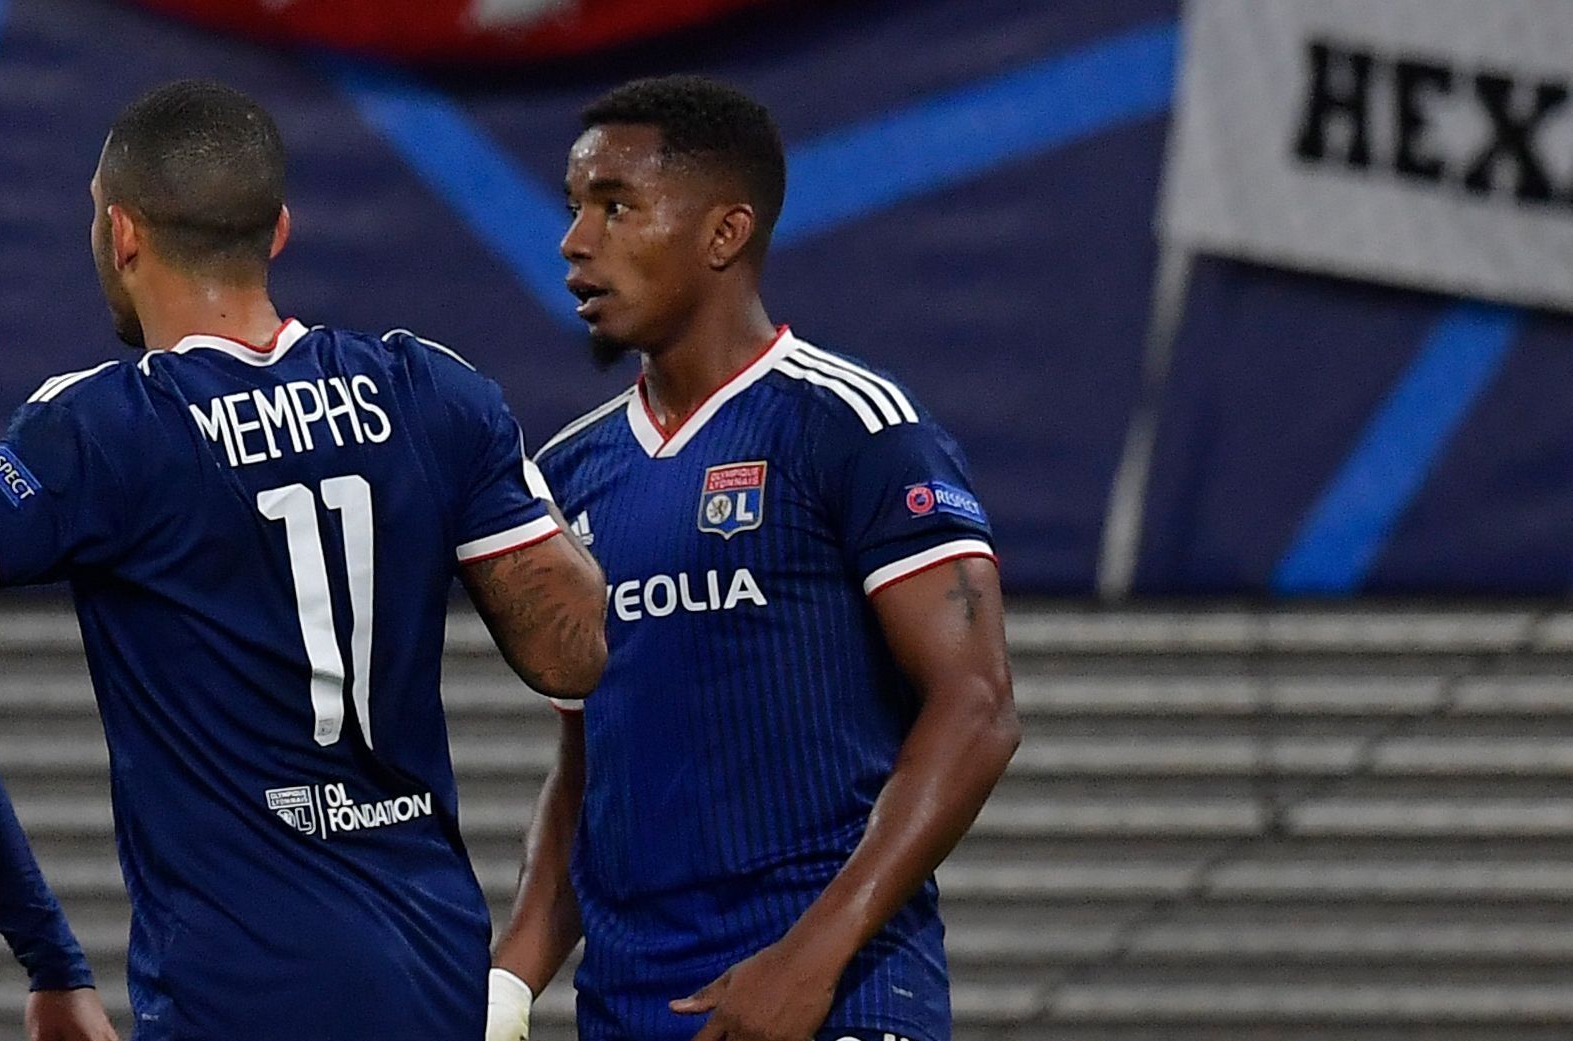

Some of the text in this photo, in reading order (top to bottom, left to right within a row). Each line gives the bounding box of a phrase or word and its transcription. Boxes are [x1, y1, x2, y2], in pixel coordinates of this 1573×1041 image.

[1294, 42, 1573, 207] HEX
[256, 474, 374, 751] 11
[325, 783, 353, 807] OL
[327, 793, 432, 832] FONDATION
